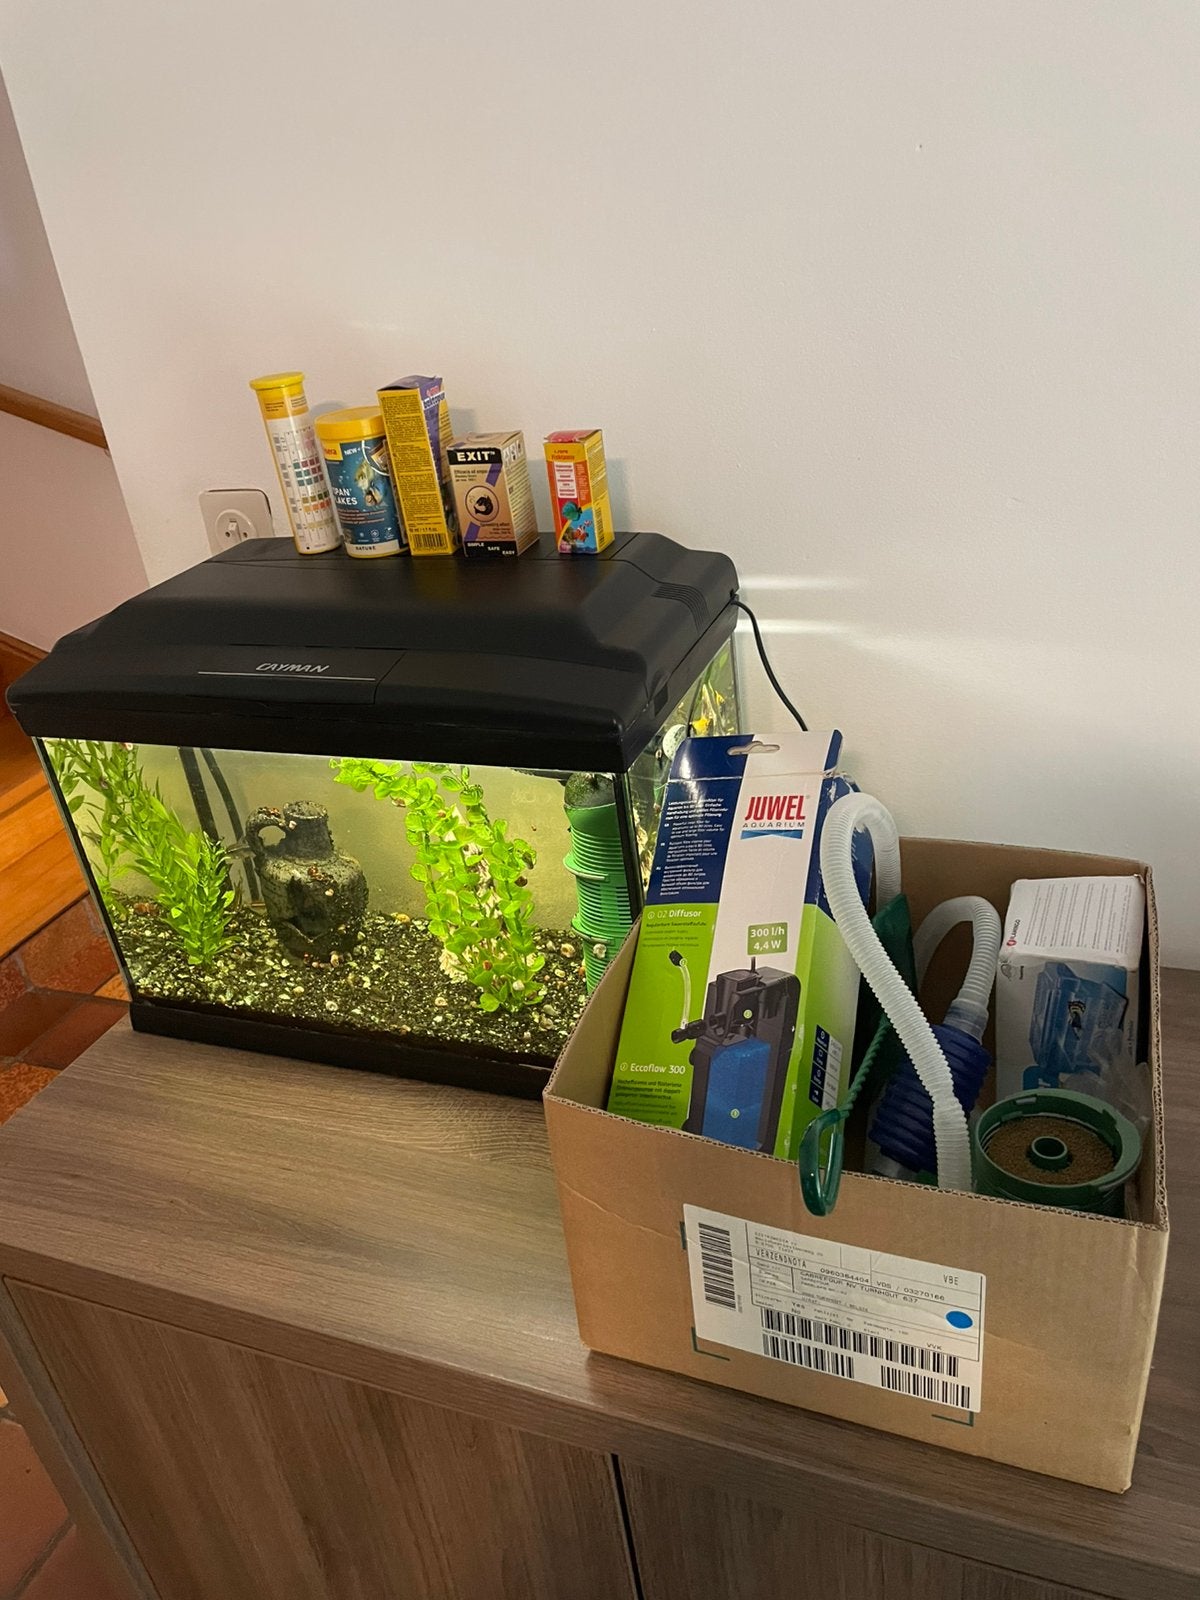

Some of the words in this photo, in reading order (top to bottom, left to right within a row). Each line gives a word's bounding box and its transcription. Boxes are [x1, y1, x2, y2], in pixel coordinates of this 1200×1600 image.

[456, 451, 490, 462] EXIT
[255, 662, 330, 673] CAYMAN
[744, 795, 806, 821] JUWEL
[668, 909, 702, 918] Diffusor
[750, 928, 770, 938] 300
[771, 926, 785, 936] l/h
[753, 940, 769, 951] 4,4
[770, 940, 782, 950] W
[630, 1062, 667, 1073] Eccoflow
[668, 1064, 686, 1075] 300
[755, 1247, 807, 1269] VERZENDNOTA
[943, 1274, 960, 1286] VBE
[860, 1285, 899, 1299] TURNHOUT
